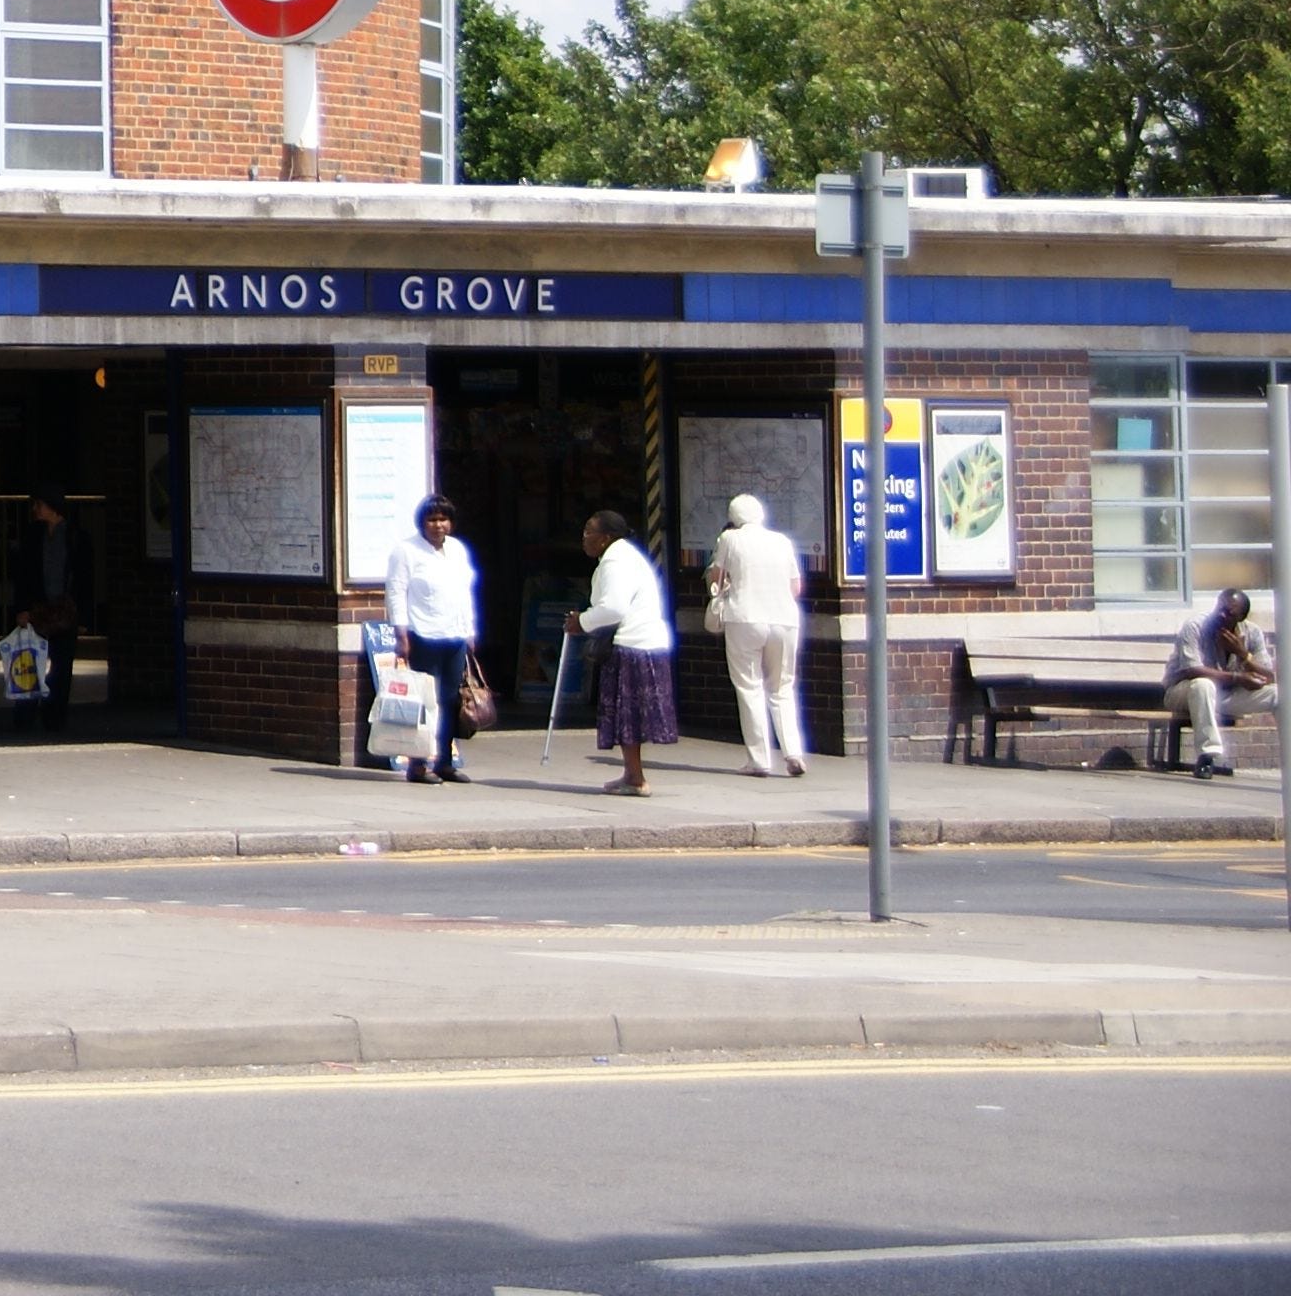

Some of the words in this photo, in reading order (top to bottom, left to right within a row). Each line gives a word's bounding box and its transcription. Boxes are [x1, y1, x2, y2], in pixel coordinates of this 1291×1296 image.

[170, 274, 338, 310] ARNOS
[400, 276, 555, 312] GROVE
[368, 357, 395, 372] RVP
[852, 449, 866, 470] N
[852, 474, 916, 500] pking
